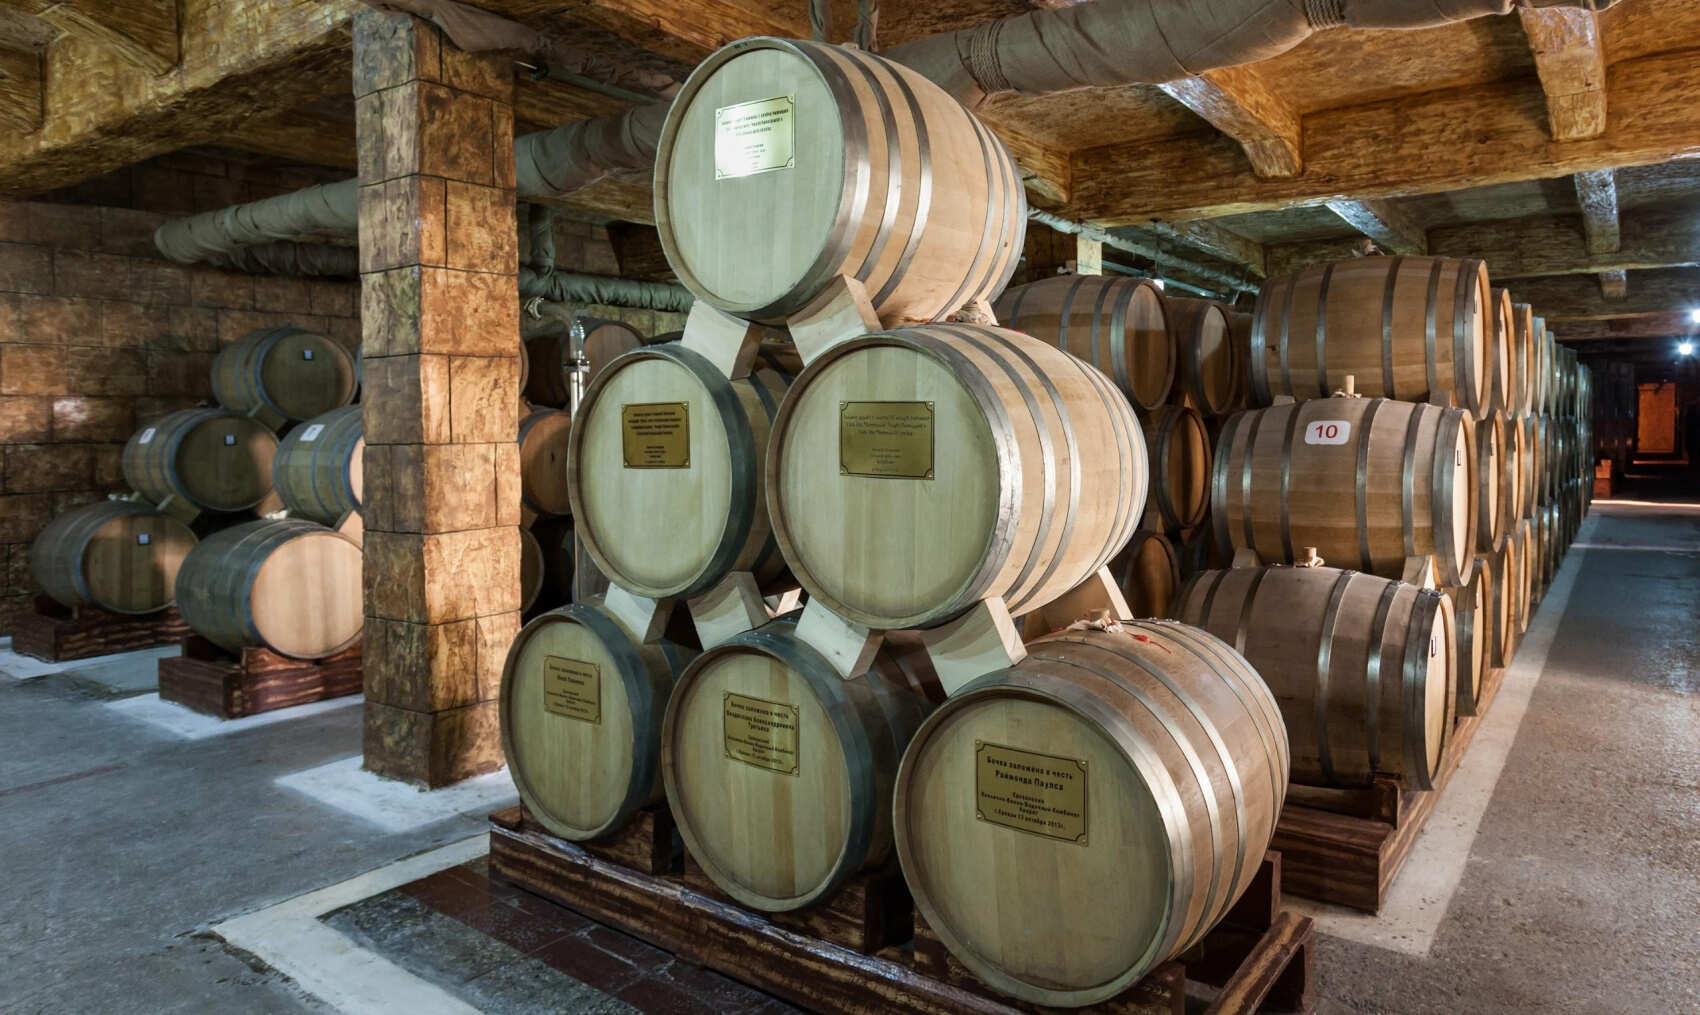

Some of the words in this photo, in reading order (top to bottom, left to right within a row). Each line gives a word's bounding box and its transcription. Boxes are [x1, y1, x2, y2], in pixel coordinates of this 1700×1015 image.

[1315, 424, 1338, 438] 10
[987, 755, 1007, 768] Бочка
[1009, 761, 1045, 774] заложена
[1052, 771, 1073, 780] честь
[995, 770, 1032, 785] Раймонда
